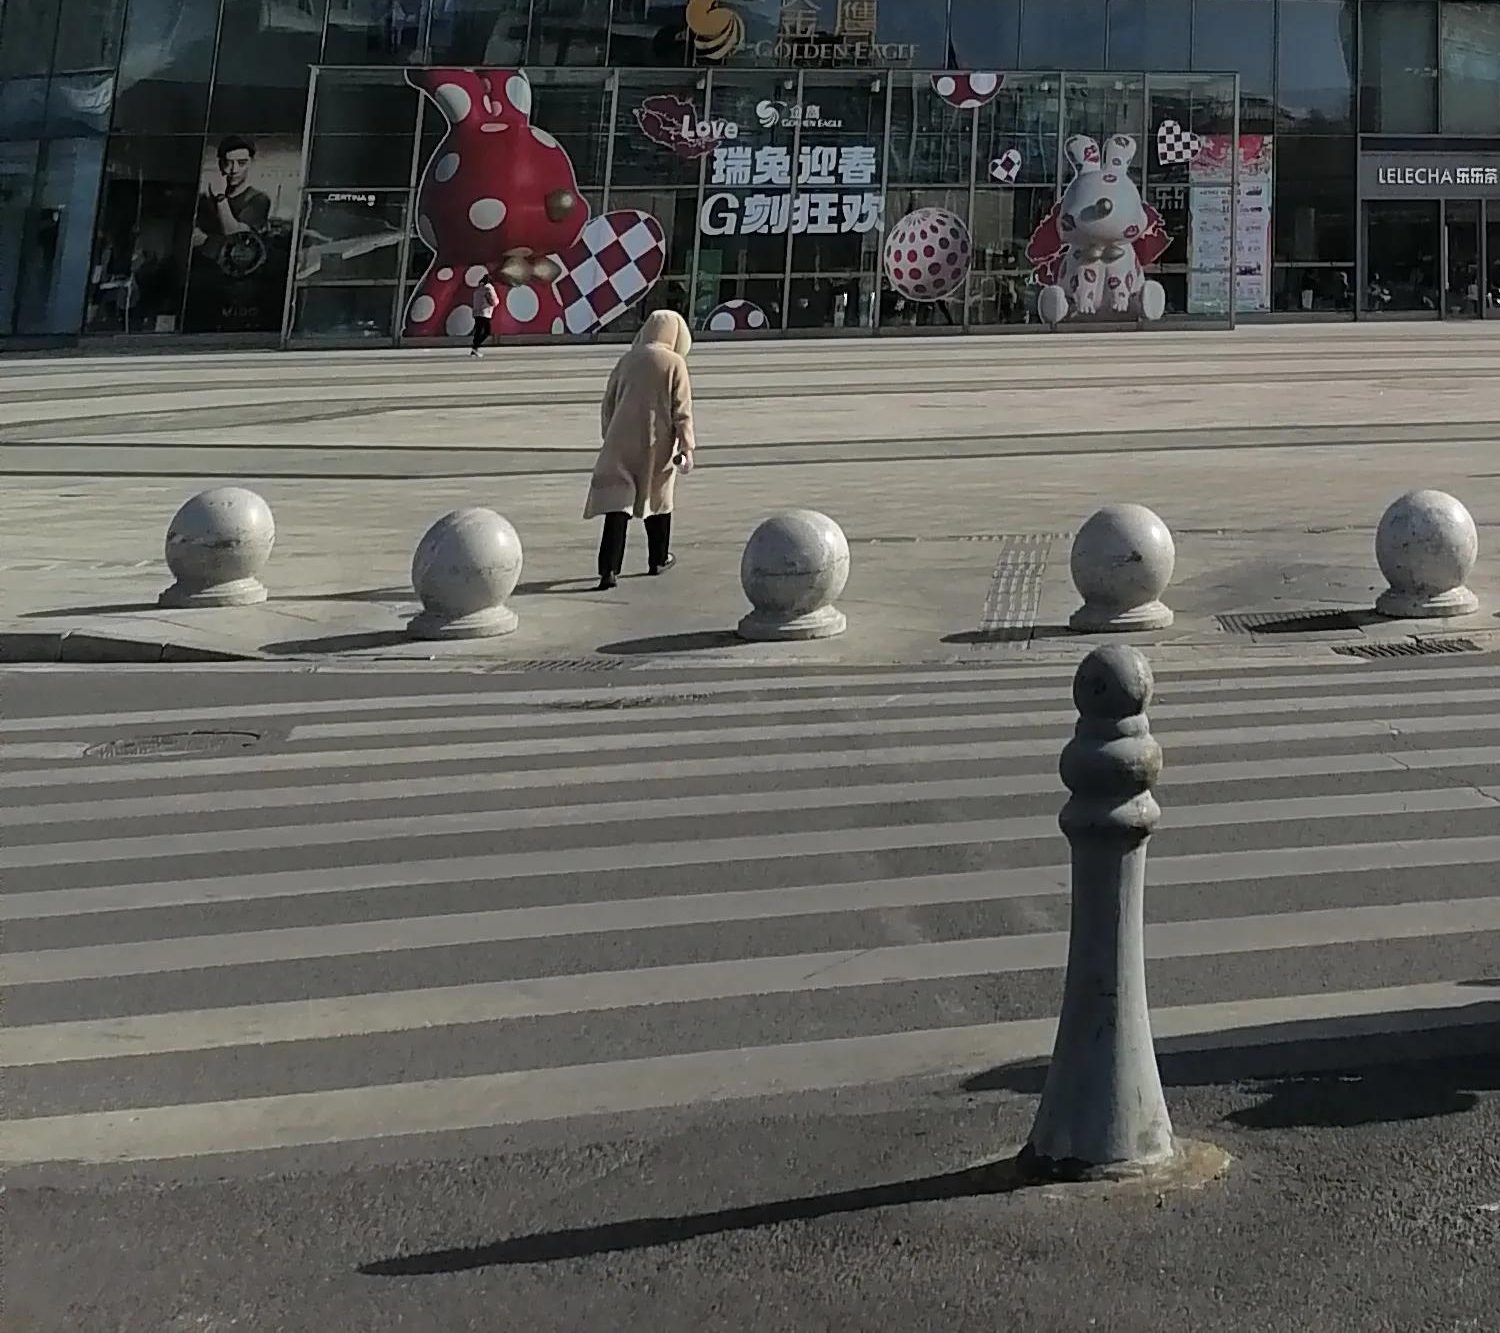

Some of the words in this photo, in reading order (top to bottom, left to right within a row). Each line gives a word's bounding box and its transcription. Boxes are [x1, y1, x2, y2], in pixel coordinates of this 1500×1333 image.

[754, 39, 848, 60] GOLDEN
[681, 115, 738, 140] Love
[711, 146, 876, 184] 瑞兔迎春
[1378, 167, 1453, 184] LELECHA
[1456, 167, 1498, 184] 乐乐茶
[700, 193, 885, 235] G刻狂欢
